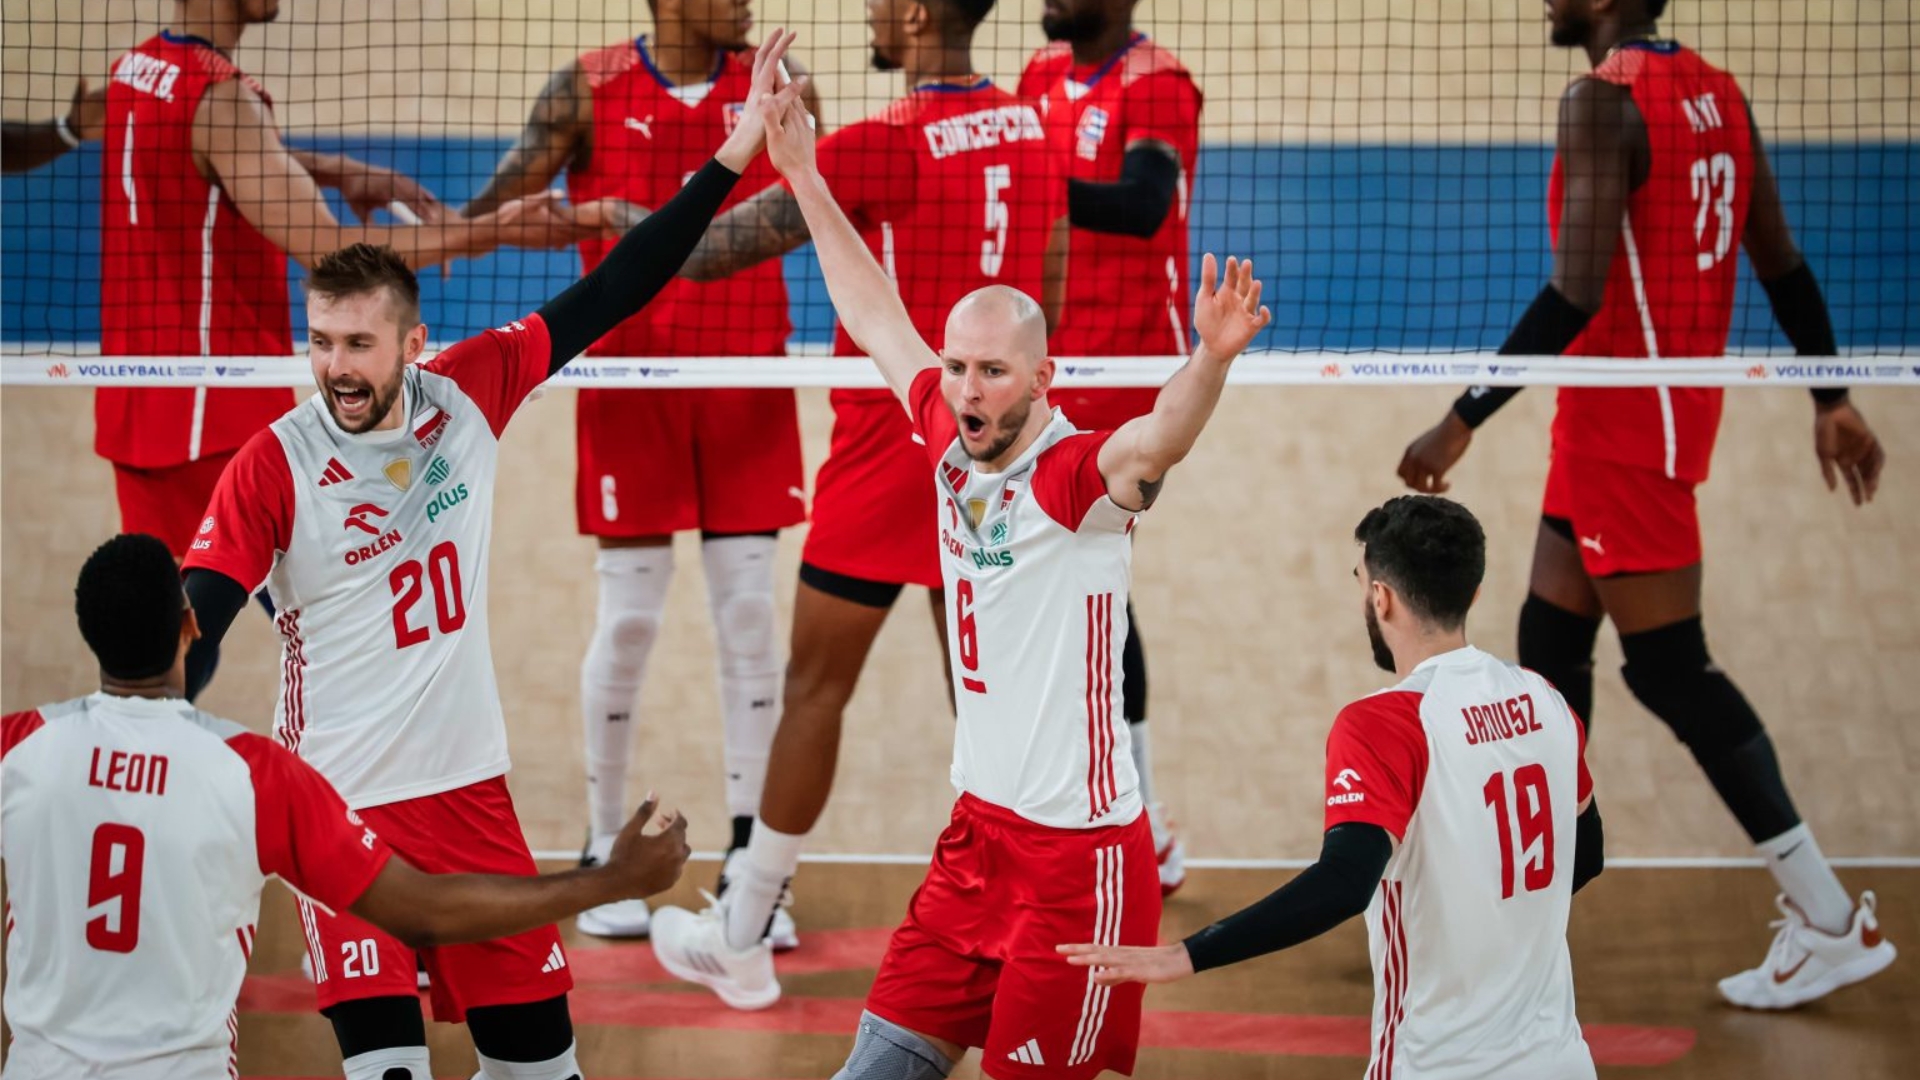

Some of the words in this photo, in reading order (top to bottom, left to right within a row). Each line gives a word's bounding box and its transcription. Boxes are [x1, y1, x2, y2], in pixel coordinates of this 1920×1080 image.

[121, 110, 138, 225] 1
[979, 163, 1011, 277] 5
[1689, 152, 1736, 272] 23
[78, 365, 174, 376] VOLLEYBALL
[557, 366, 599, 377] BALL
[1351, 363, 1448, 375] VOLLEYBALL
[1775, 365, 1872, 377] VOLLEYBALL
[426, 482, 469, 524] plus
[600, 474, 619, 522] 6
[344, 529, 403, 566] ORLEN
[971, 547, 1015, 570] plus
[389, 540, 466, 650] 20
[956, 577, 979, 672] 6
[1461, 693, 1543, 746] JANUSZ
[88, 746, 169, 796] LEON
[1327, 792, 1365, 806] ORLEN
[1483, 763, 1555, 900] 19
[86, 822, 146, 954] 9
[341, 938, 380, 978] 20
